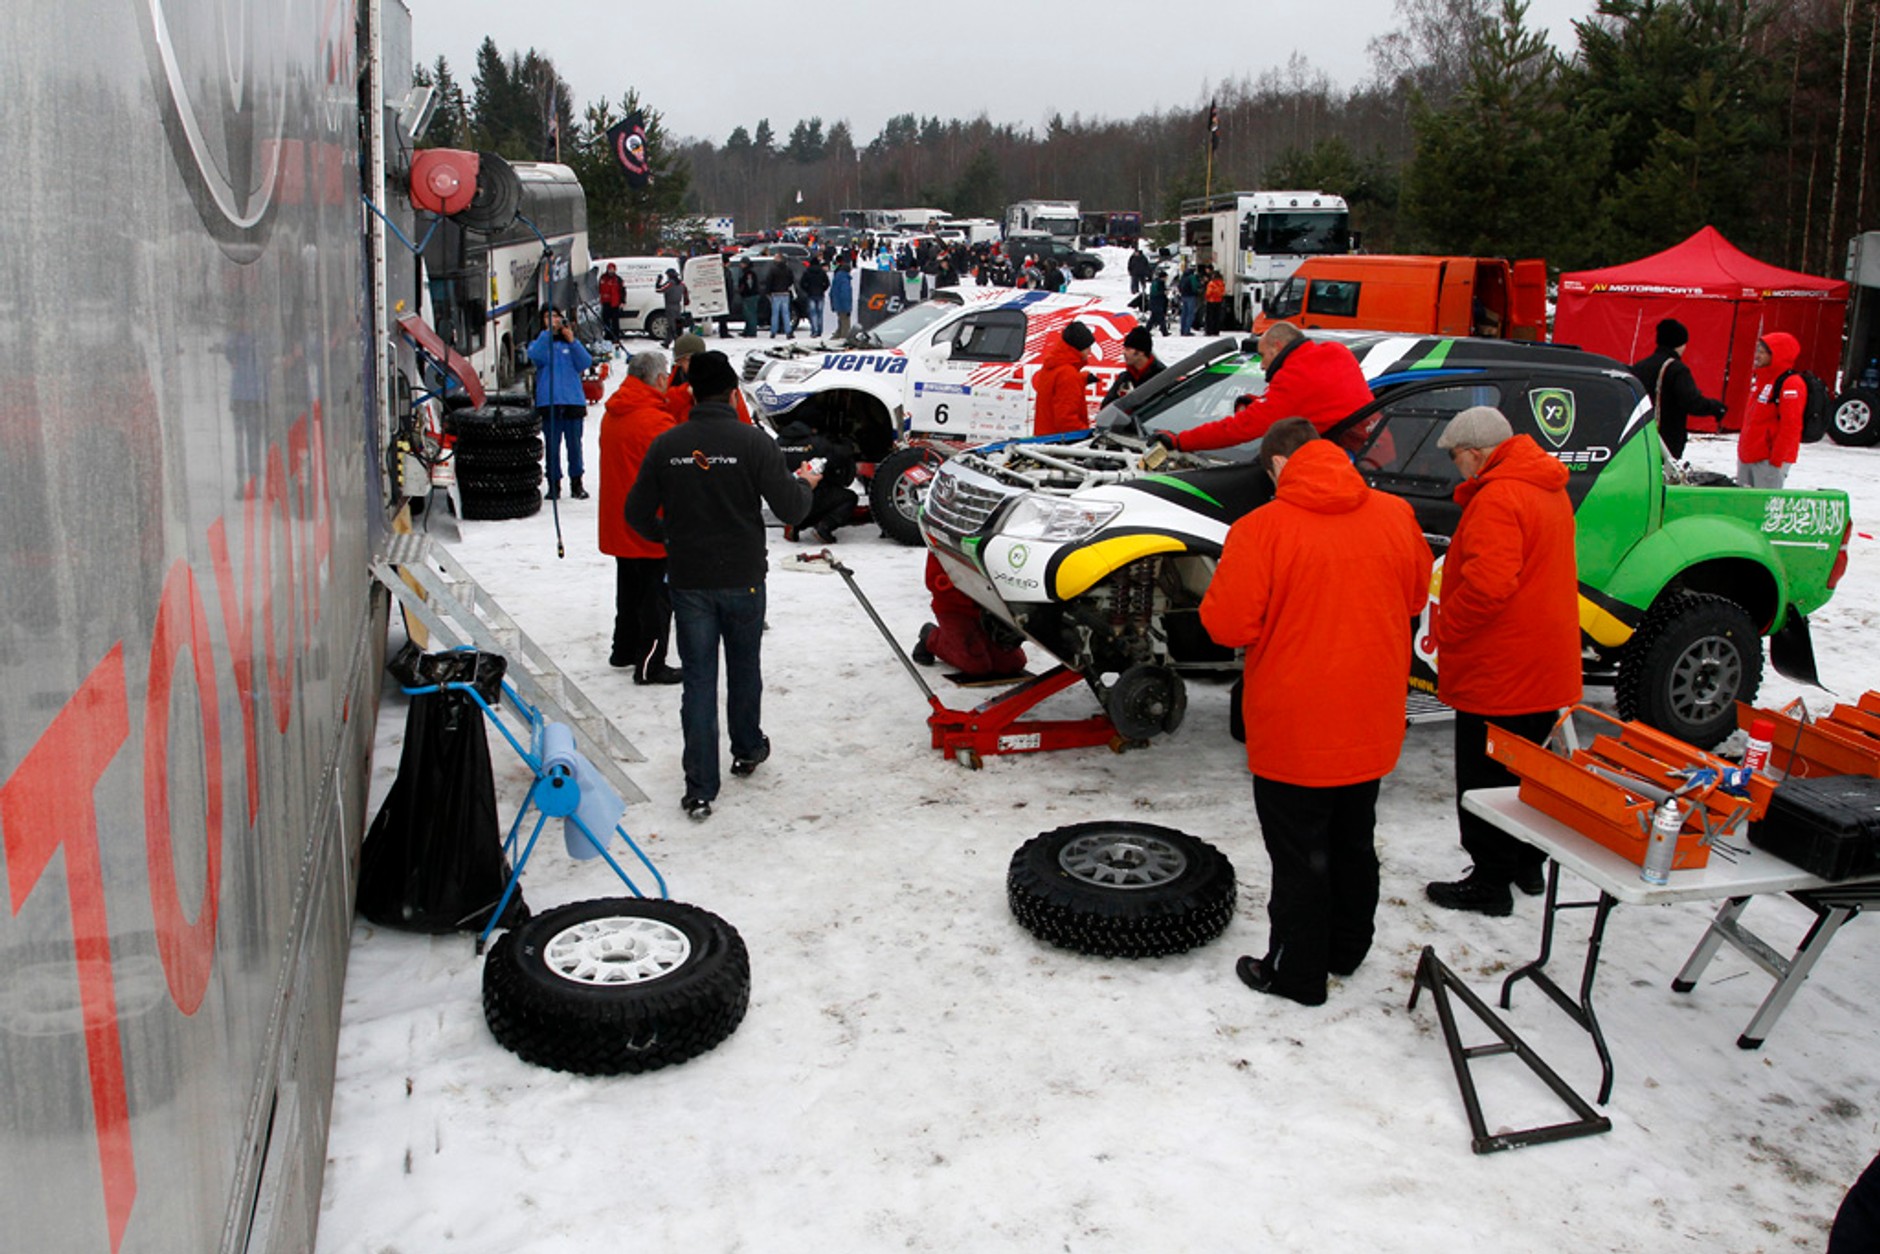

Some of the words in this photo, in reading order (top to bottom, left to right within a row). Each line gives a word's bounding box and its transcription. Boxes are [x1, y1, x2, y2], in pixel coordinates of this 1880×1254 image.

[1608, 284, 1703, 295] MOTORSPORTS
[822, 354, 909, 374] verva
[934, 403, 949, 425] 6
[1546, 446, 1611, 462] EED
[0, 398, 334, 1254] TOYOTA
